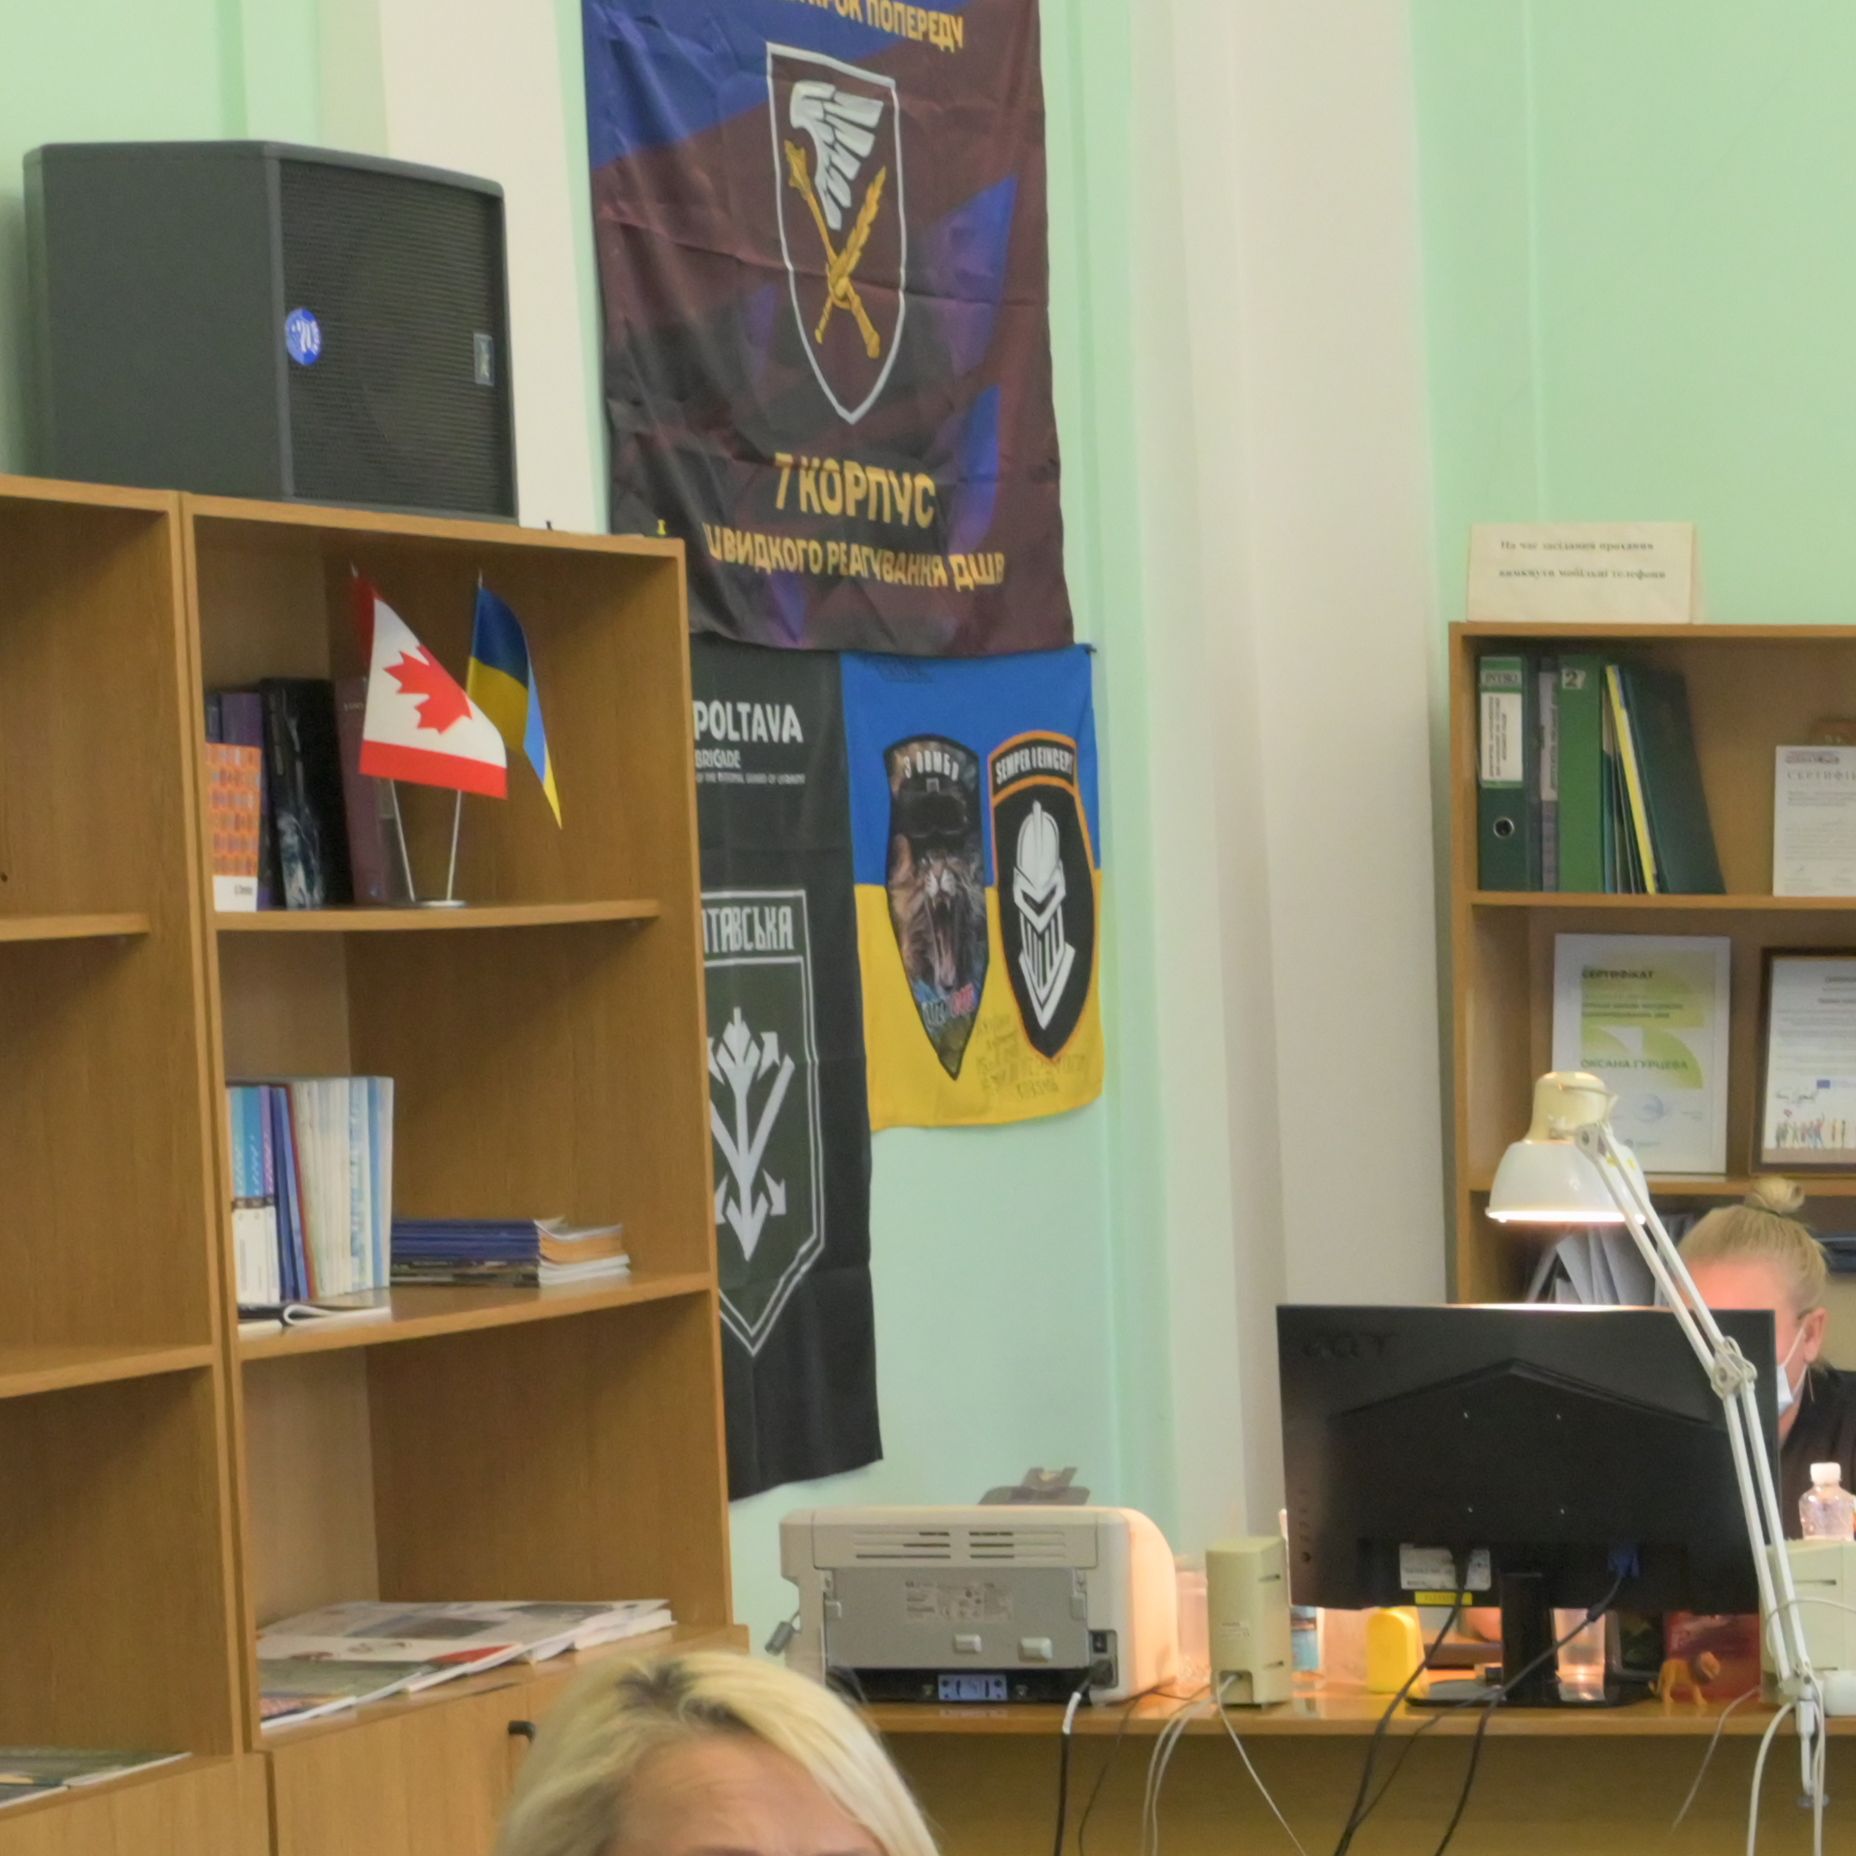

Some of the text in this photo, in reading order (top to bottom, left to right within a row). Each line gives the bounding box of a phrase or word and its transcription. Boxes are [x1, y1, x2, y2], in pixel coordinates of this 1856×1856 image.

[868, 0, 964, 54] ПОПЕРЕДУ
[775, 452, 936, 529] 7 КОРПУС
[827, 540, 948, 588] РЕАГУВАННЯ
[1565, 670, 1578, 687] 2
[694, 700, 804, 744] POLTAVA
[695, 748, 741, 769] BRIGADE
[996, 748, 1031, 785] SEMPER
